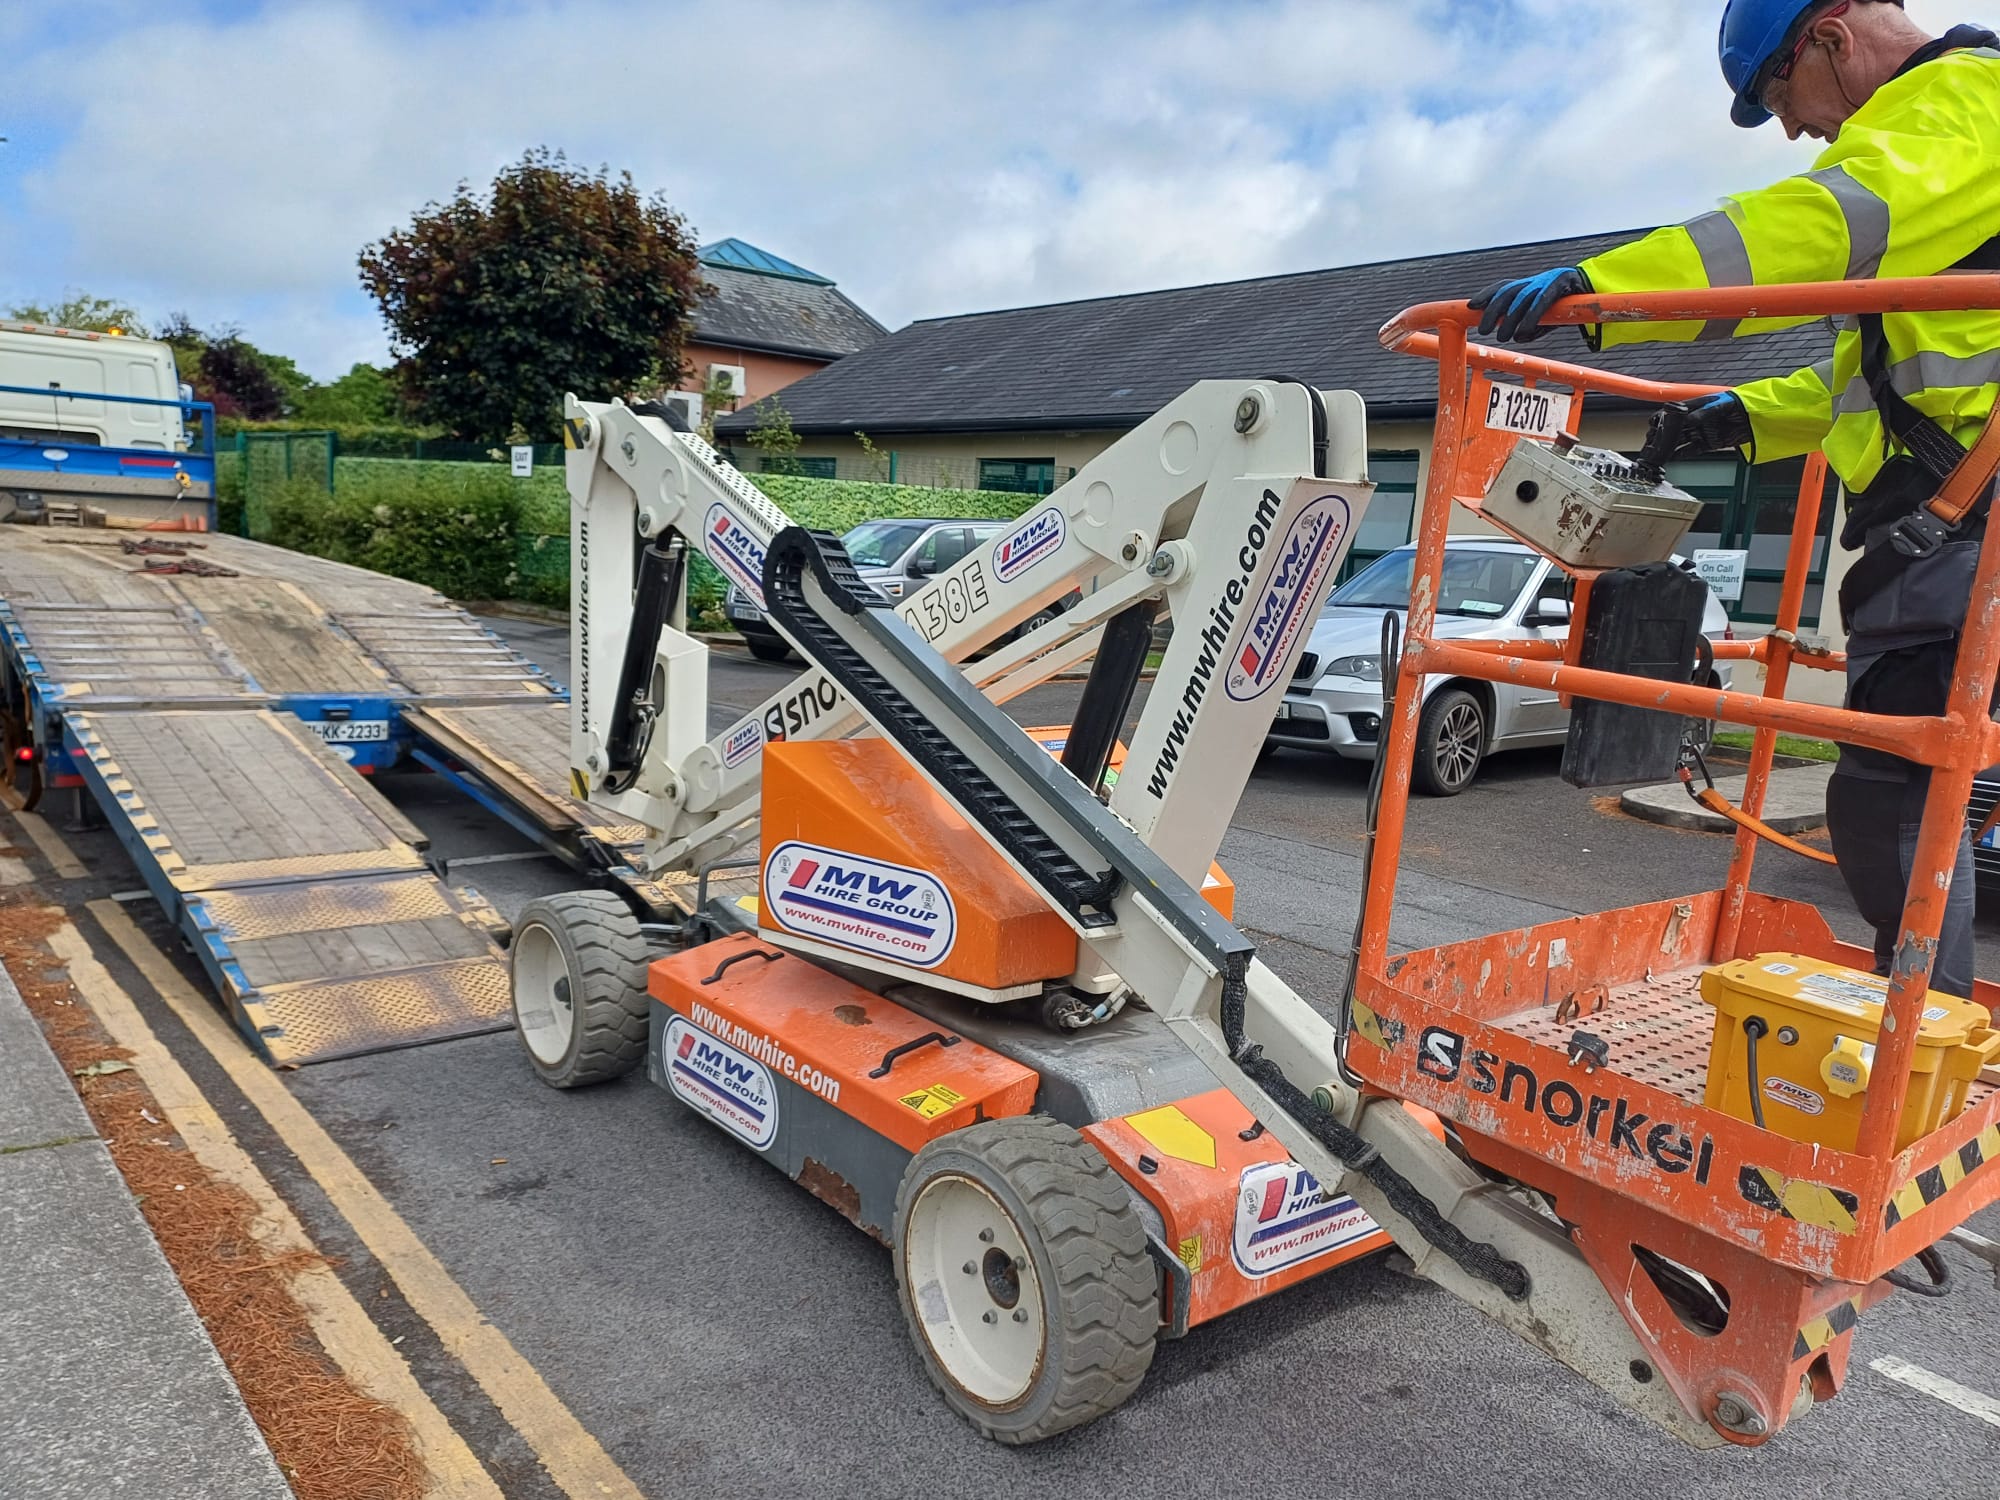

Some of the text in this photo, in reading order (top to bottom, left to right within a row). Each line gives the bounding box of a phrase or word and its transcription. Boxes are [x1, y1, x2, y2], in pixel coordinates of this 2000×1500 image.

[1486, 386, 1548, 432] P 12370
[724, 536, 746, 558] HIRE
[1012, 520, 1058, 557] HIRE GROUP
[1013, 517, 1047, 550] MW
[1253, 533, 1301, 639] MW
[1262, 594, 1288, 648] HIRE
[1288, 511, 1324, 590] GROUP
[1702, 563, 1734, 572] On Call
[1266, 523, 1341, 679] www.mwhire.com
[579, 521, 589, 734] www.mwhire.com
[1146, 487, 1281, 801] www.mwhire.com
[814, 884, 862, 903] HIRE
[865, 897, 939, 922] GROUP
[820, 865, 918, 901] MW
[784, 906, 928, 953] www.mwhire.com
[691, 1001, 841, 1103] www.mwhire.com
[696, 1042, 755, 1084] MW
[674, 1075, 761, 1136] www.mwhire.com
[692, 1058, 768, 1107] HIRE GROUP
[1783, 1086, 1813, 1099] MW
[1467, 1049, 1715, 1187] snorkel
[1287, 1193, 1322, 1215] HIR
